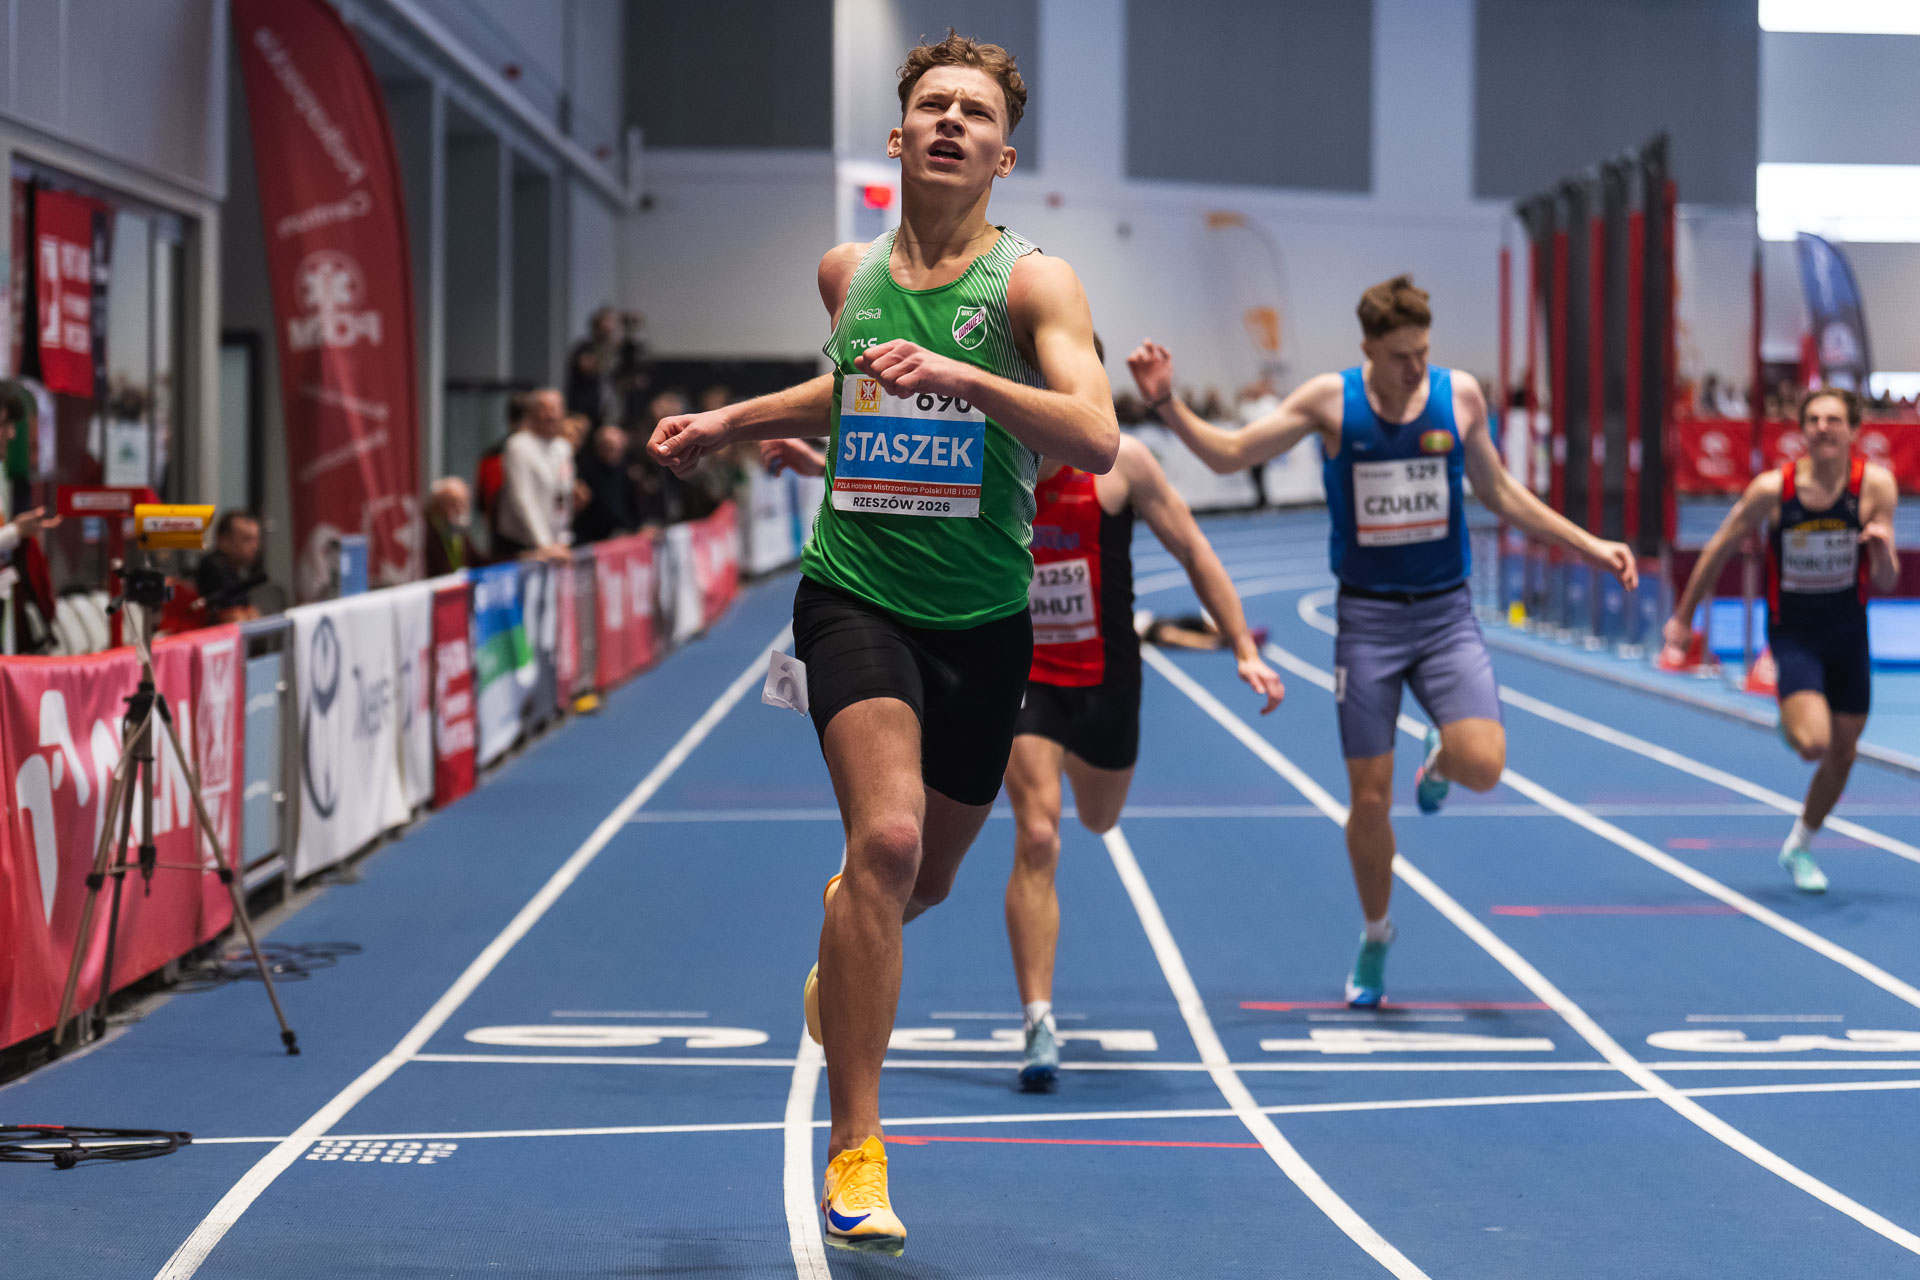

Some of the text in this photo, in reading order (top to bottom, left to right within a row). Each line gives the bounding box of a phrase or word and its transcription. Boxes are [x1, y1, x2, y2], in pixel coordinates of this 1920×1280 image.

[856, 401, 878, 412] PZLA
[844, 432, 974, 468] STASZEK
[851, 482, 872, 490] Halowe
[873, 483, 918, 493] Mistrzostwa
[920, 486, 943, 495] Polski
[943, 487, 957, 495] U18
[962, 488, 977, 496] U20
[853, 496, 951, 512] RZESZÓW 2026
[1037, 566, 1084, 586] 1259
